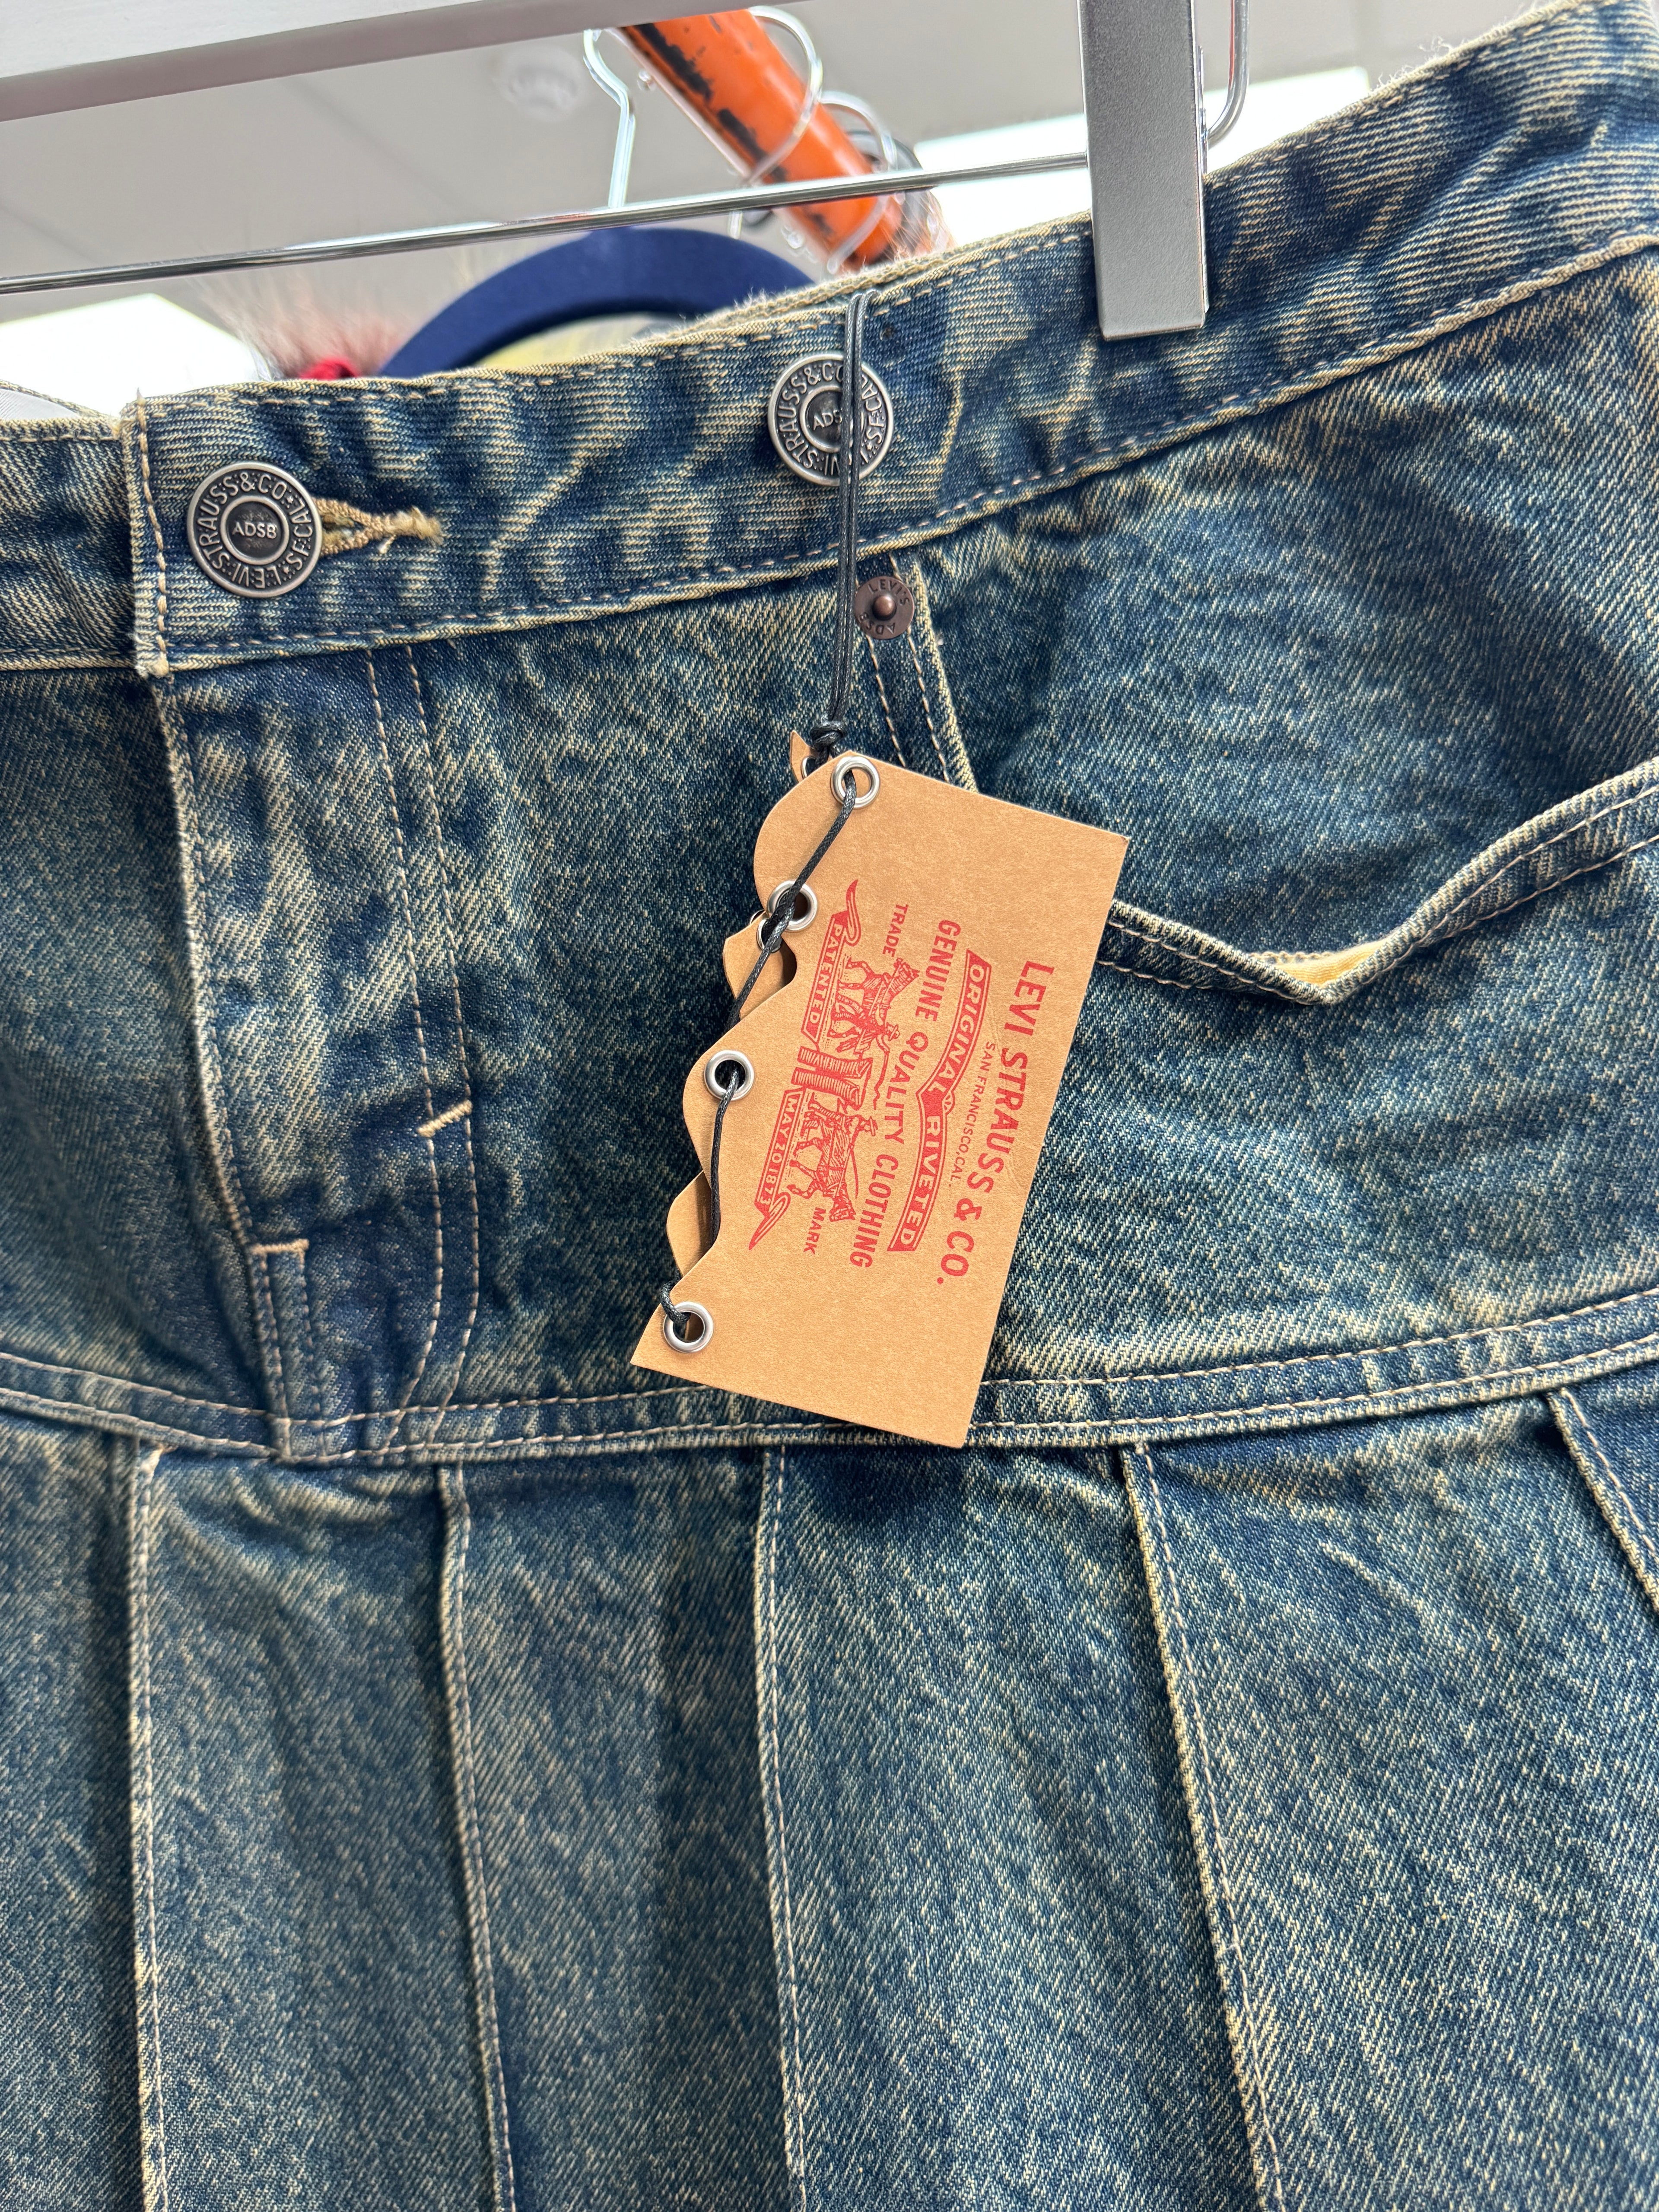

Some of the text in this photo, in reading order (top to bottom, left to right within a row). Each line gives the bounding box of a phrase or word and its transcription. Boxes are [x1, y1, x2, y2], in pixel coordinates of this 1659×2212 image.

[812, 409, 843, 431] ADS
[232, 522, 277, 539] ADSB
[232, 563, 281, 589] LEVI
[882, 903, 909, 957] TRADE
[809, 923, 843, 1024] PATENTED
[979, 1041, 996, 1072] SAN
[849, 919, 961, 1268] GENUINE QUALITY CLOTHING
[900, 964, 985, 1245] ORIGINAL RIVETED
[936, 960, 1055, 1285] LEVI STRAUSS & CO.
[760, 1097, 798, 1205] MAY 20 1873
[803, 1207, 826, 1255] MARK
